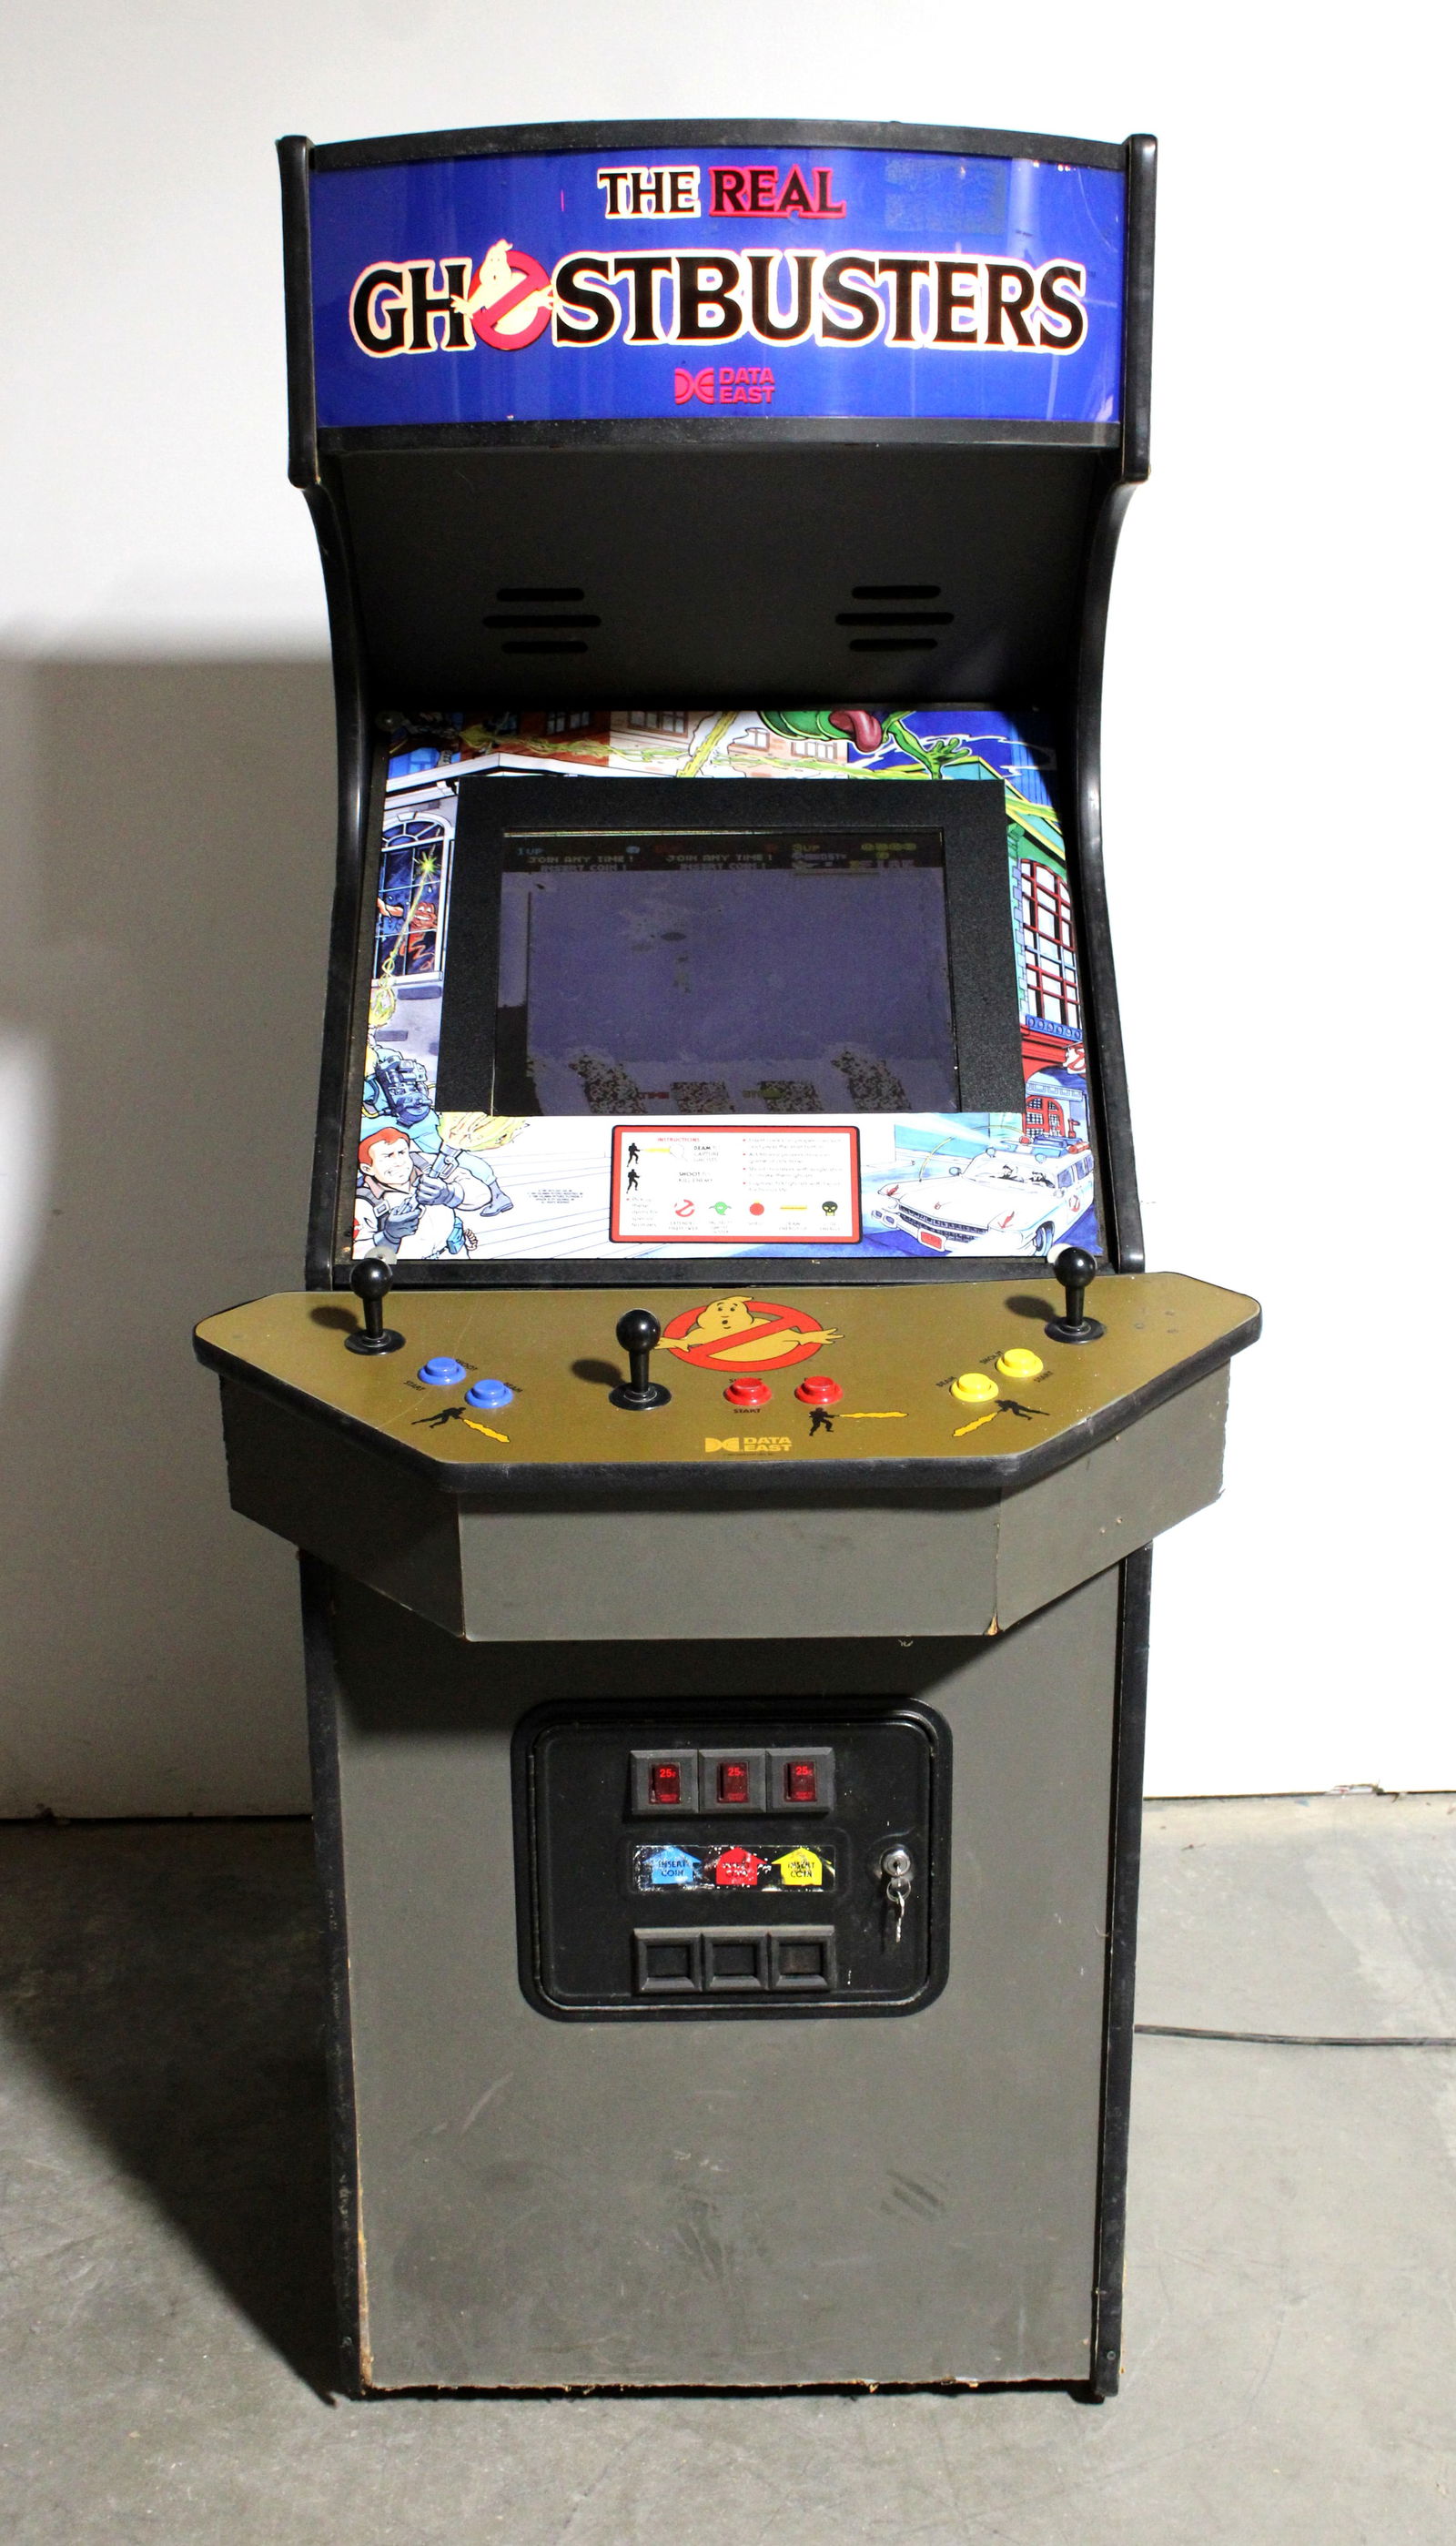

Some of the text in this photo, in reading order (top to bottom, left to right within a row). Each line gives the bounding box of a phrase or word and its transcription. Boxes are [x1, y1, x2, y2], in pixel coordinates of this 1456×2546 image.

[597, 165, 846, 218] THE REAL
[719, 367, 775, 385] DATA
[719, 386, 775, 404] EAST
[563, 856, 591, 864] ANY
[743, 1436, 792, 1445] DATA
[661, 1869, 684, 1878] COIN
[790, 1870, 813, 1879] COIN
